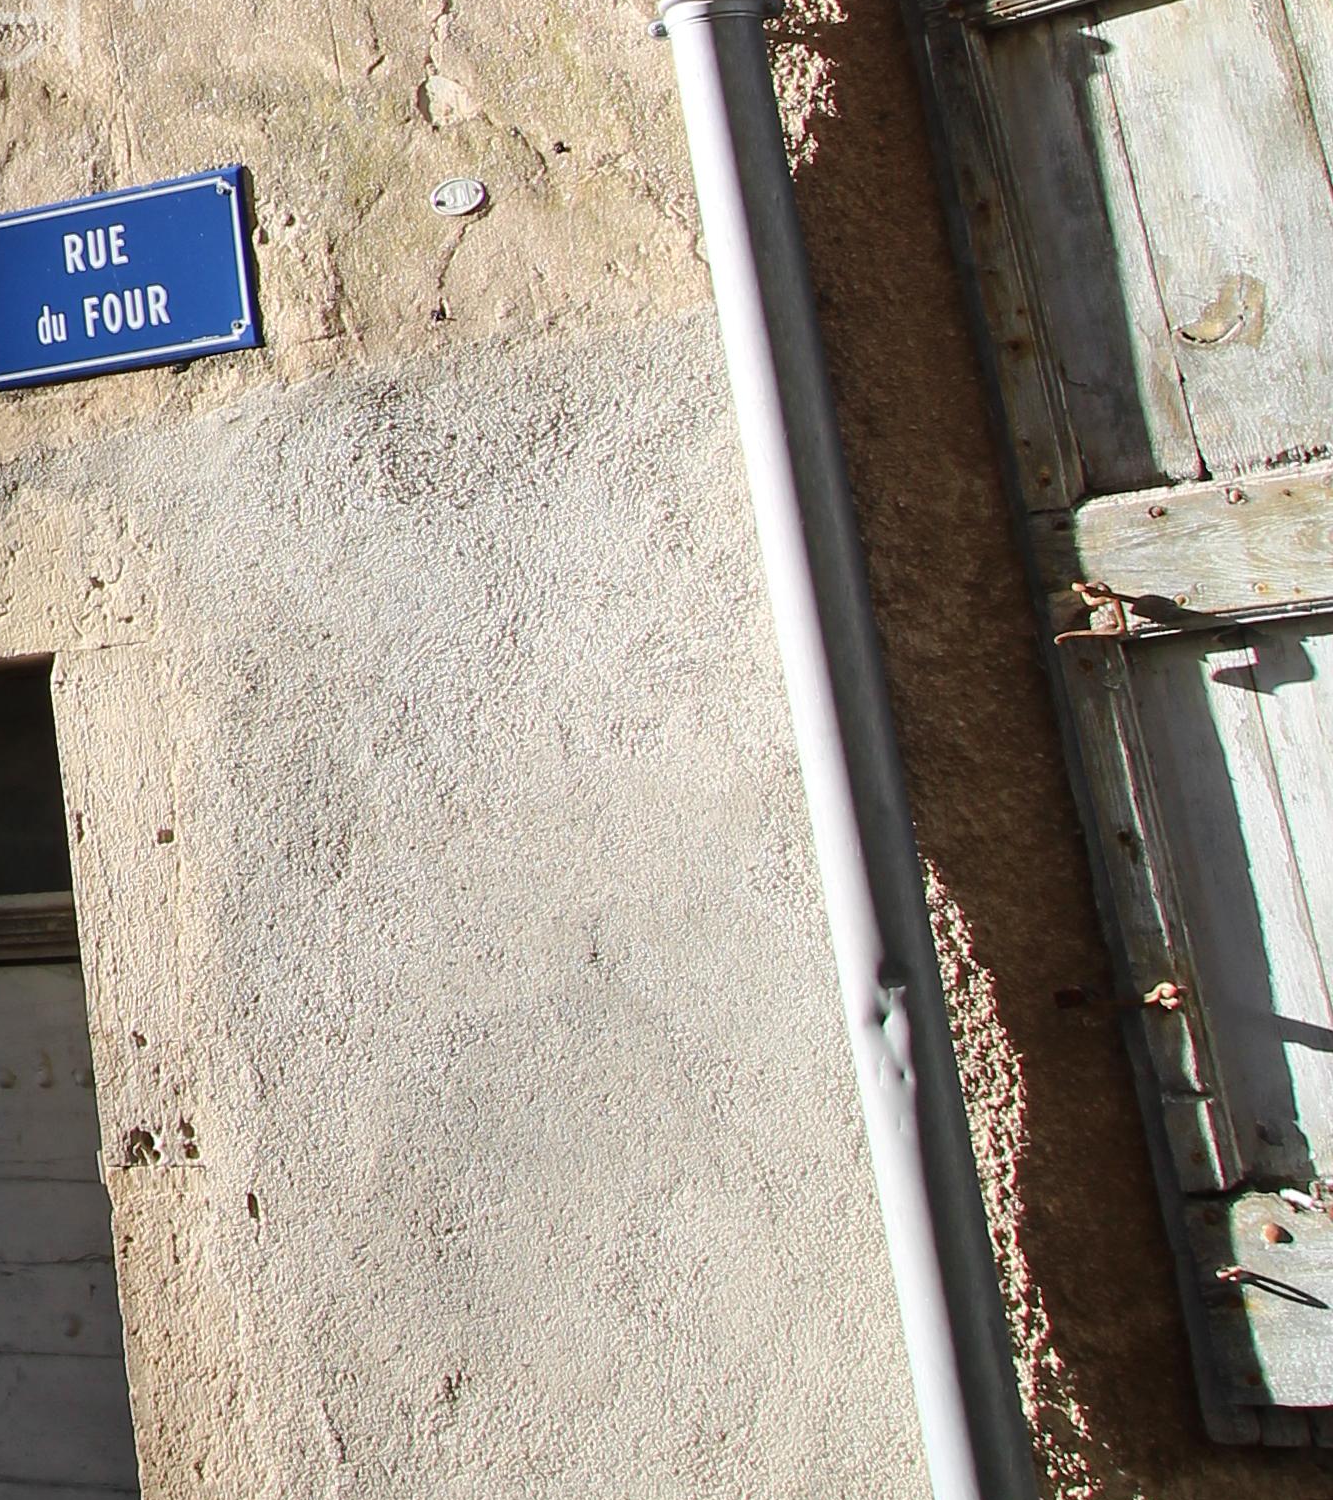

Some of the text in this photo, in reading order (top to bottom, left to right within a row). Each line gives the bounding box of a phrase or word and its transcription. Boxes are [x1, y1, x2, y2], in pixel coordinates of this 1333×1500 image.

[64, 224, 129, 274] RUE
[37, 285, 171, 345] du FOUR
